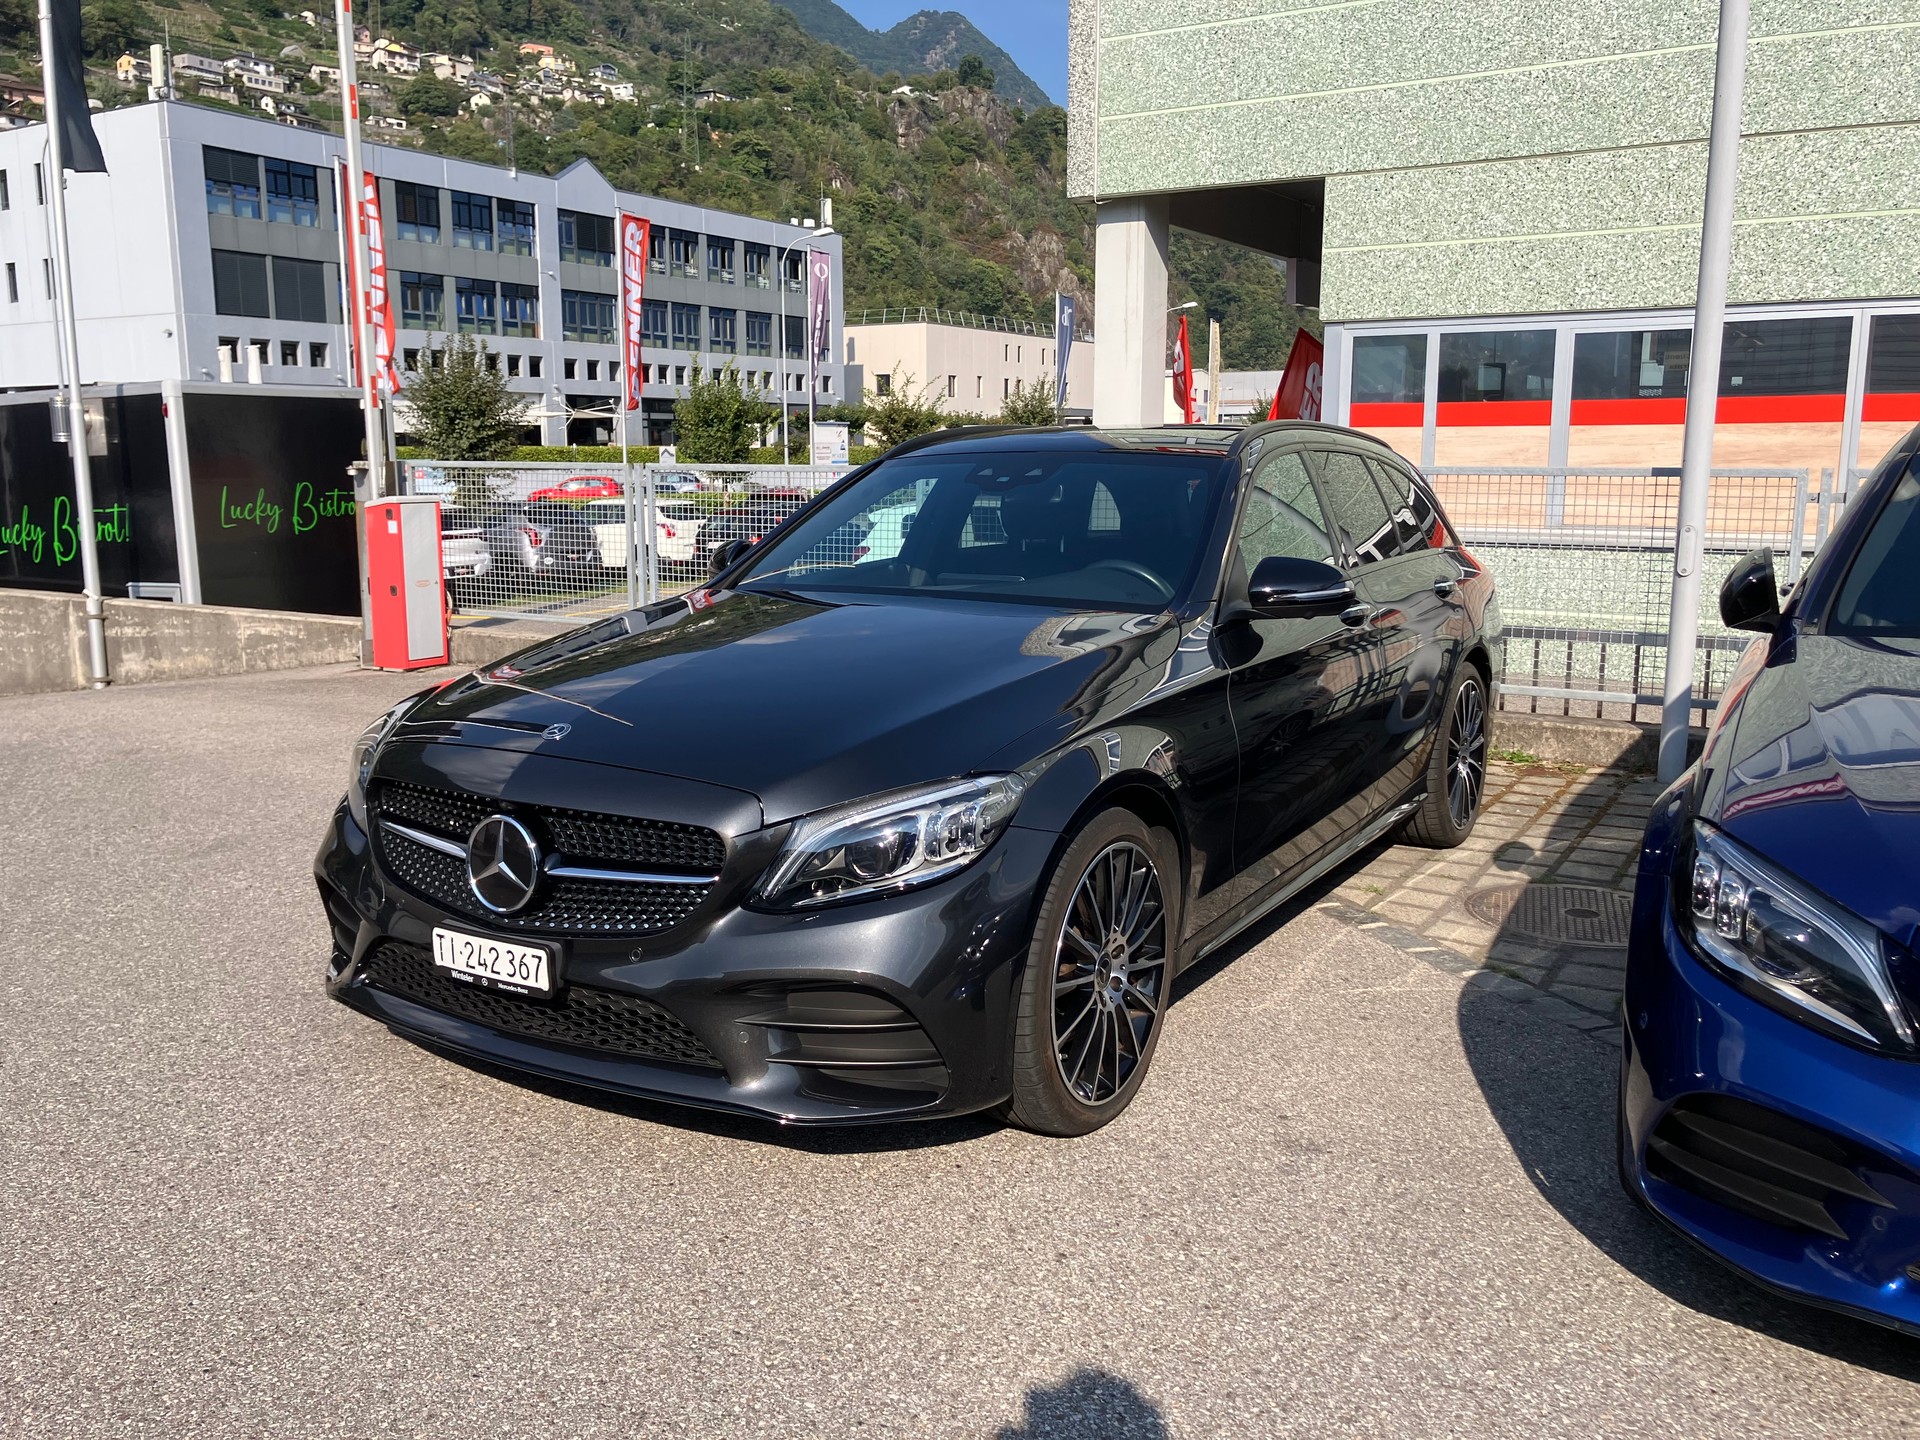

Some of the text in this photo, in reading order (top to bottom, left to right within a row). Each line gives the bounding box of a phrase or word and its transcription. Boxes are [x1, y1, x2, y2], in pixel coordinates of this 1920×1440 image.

[0, 504, 46, 563] ucky
[221, 481, 356, 535] Lucky Bistro
